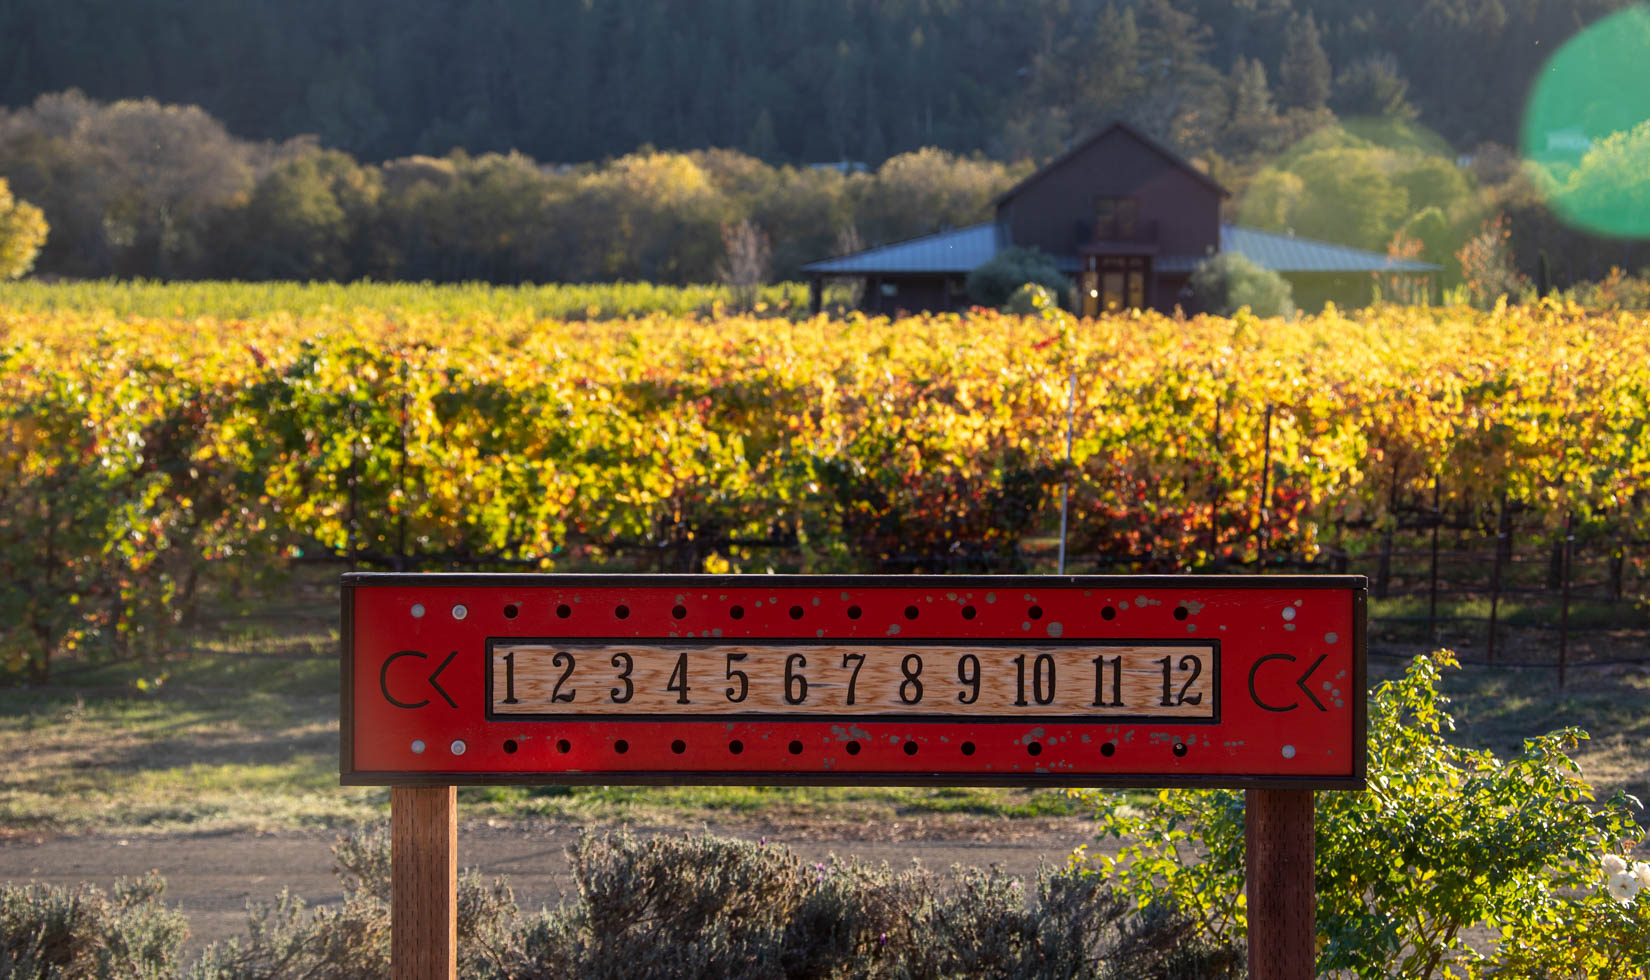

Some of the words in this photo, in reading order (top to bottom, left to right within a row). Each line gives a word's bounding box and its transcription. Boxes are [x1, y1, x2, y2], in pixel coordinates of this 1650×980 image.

[502, 652, 519, 704] 1
[551, 651, 577, 703] 2
[609, 652, 634, 704] 3
[666, 652, 691, 705] 4
[725, 652, 749, 704] 5
[783, 653, 808, 705] 6
[842, 653, 866, 706] 7
[900, 653, 924, 705] 8
[957, 653, 981, 704] 9
[1013, 653, 1057, 706] 10
[1092, 654, 1123, 707] 11
[1159, 654, 1203, 707] 12
